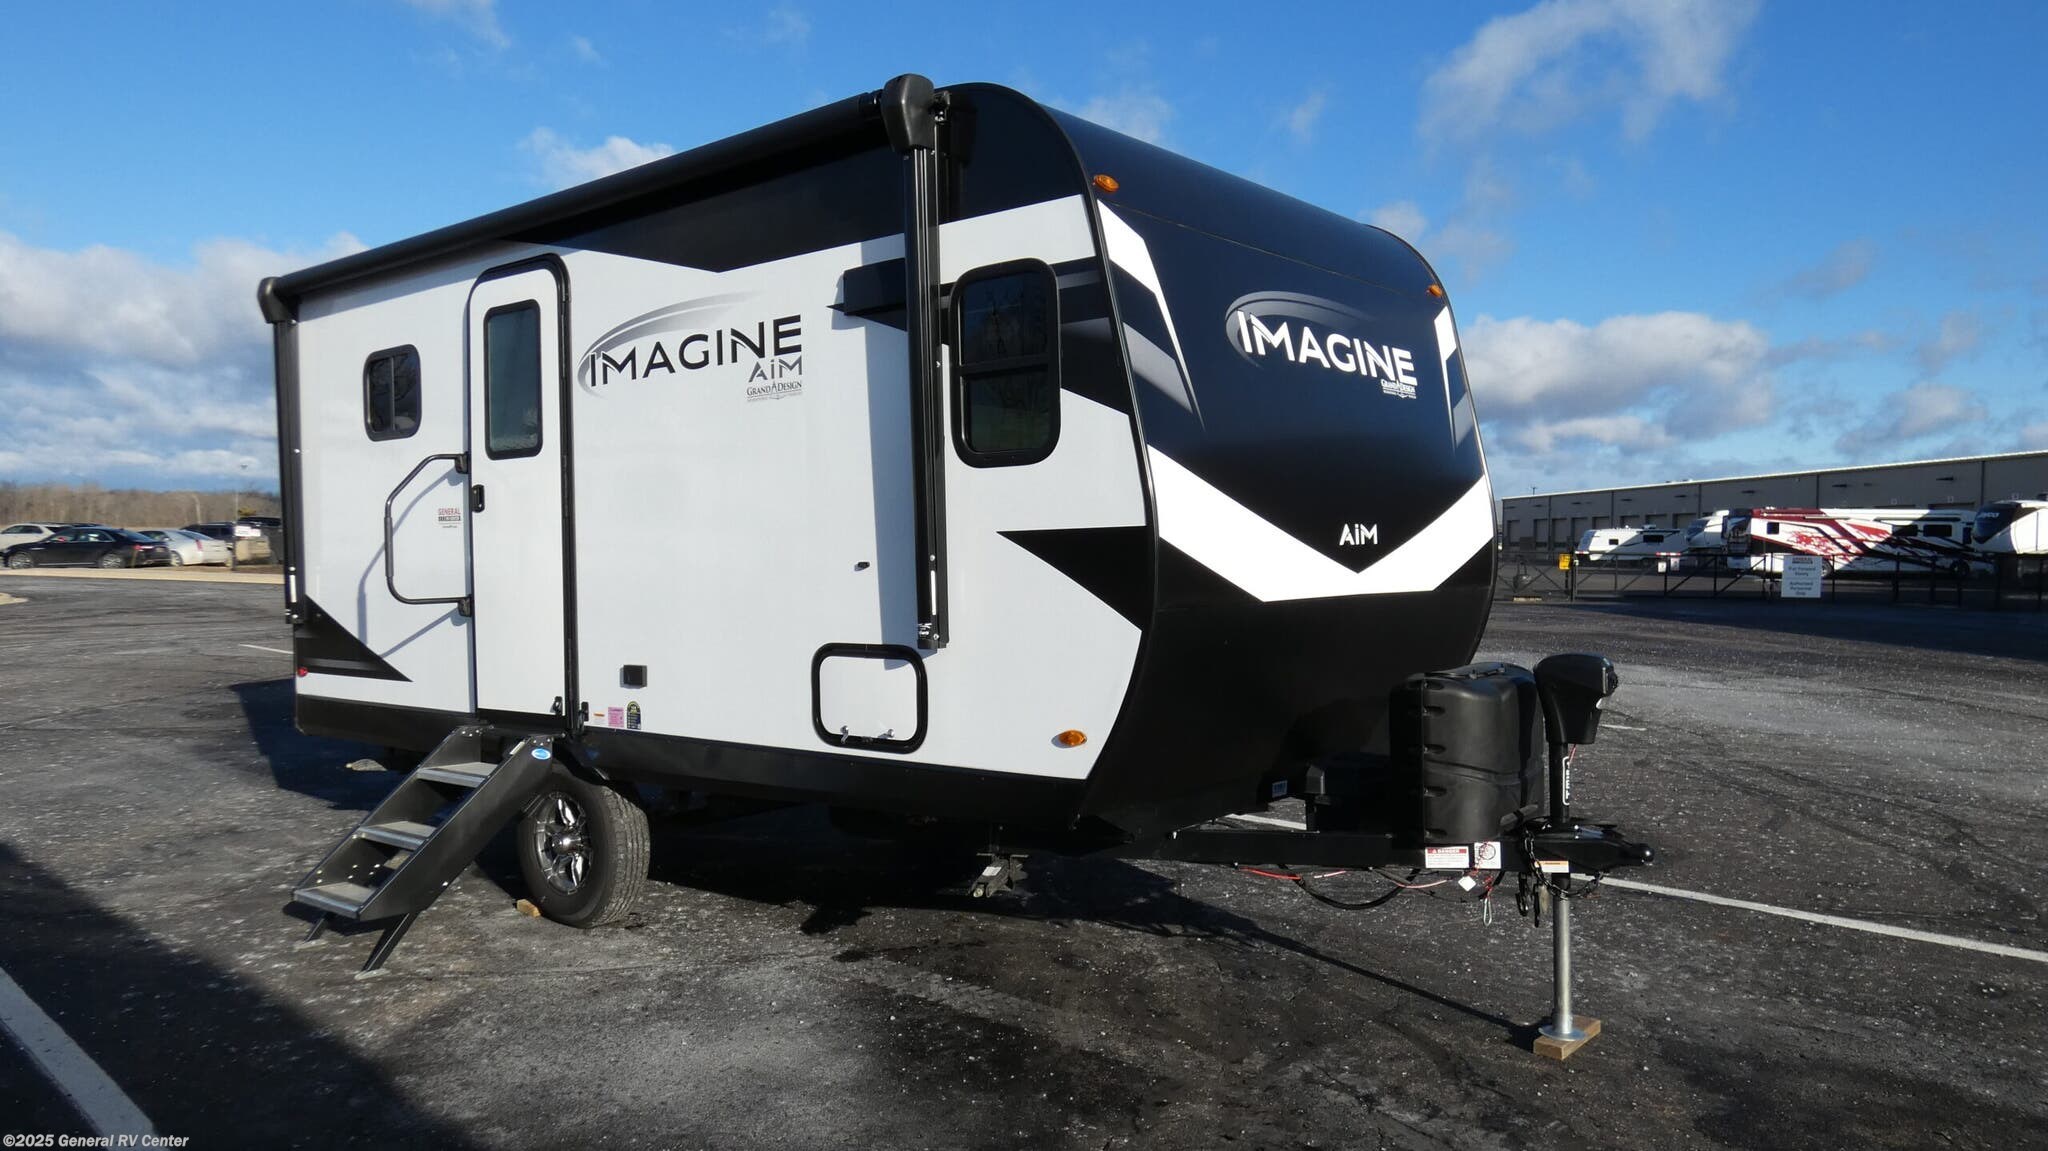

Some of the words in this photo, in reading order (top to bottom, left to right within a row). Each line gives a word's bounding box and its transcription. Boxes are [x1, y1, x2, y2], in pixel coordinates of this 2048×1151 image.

[590, 314, 802, 387] IMAGINE
[1237, 310, 1418, 386] IMAGINE
[746, 384, 771, 396] GRAND
[777, 381, 802, 392] DESIGN
